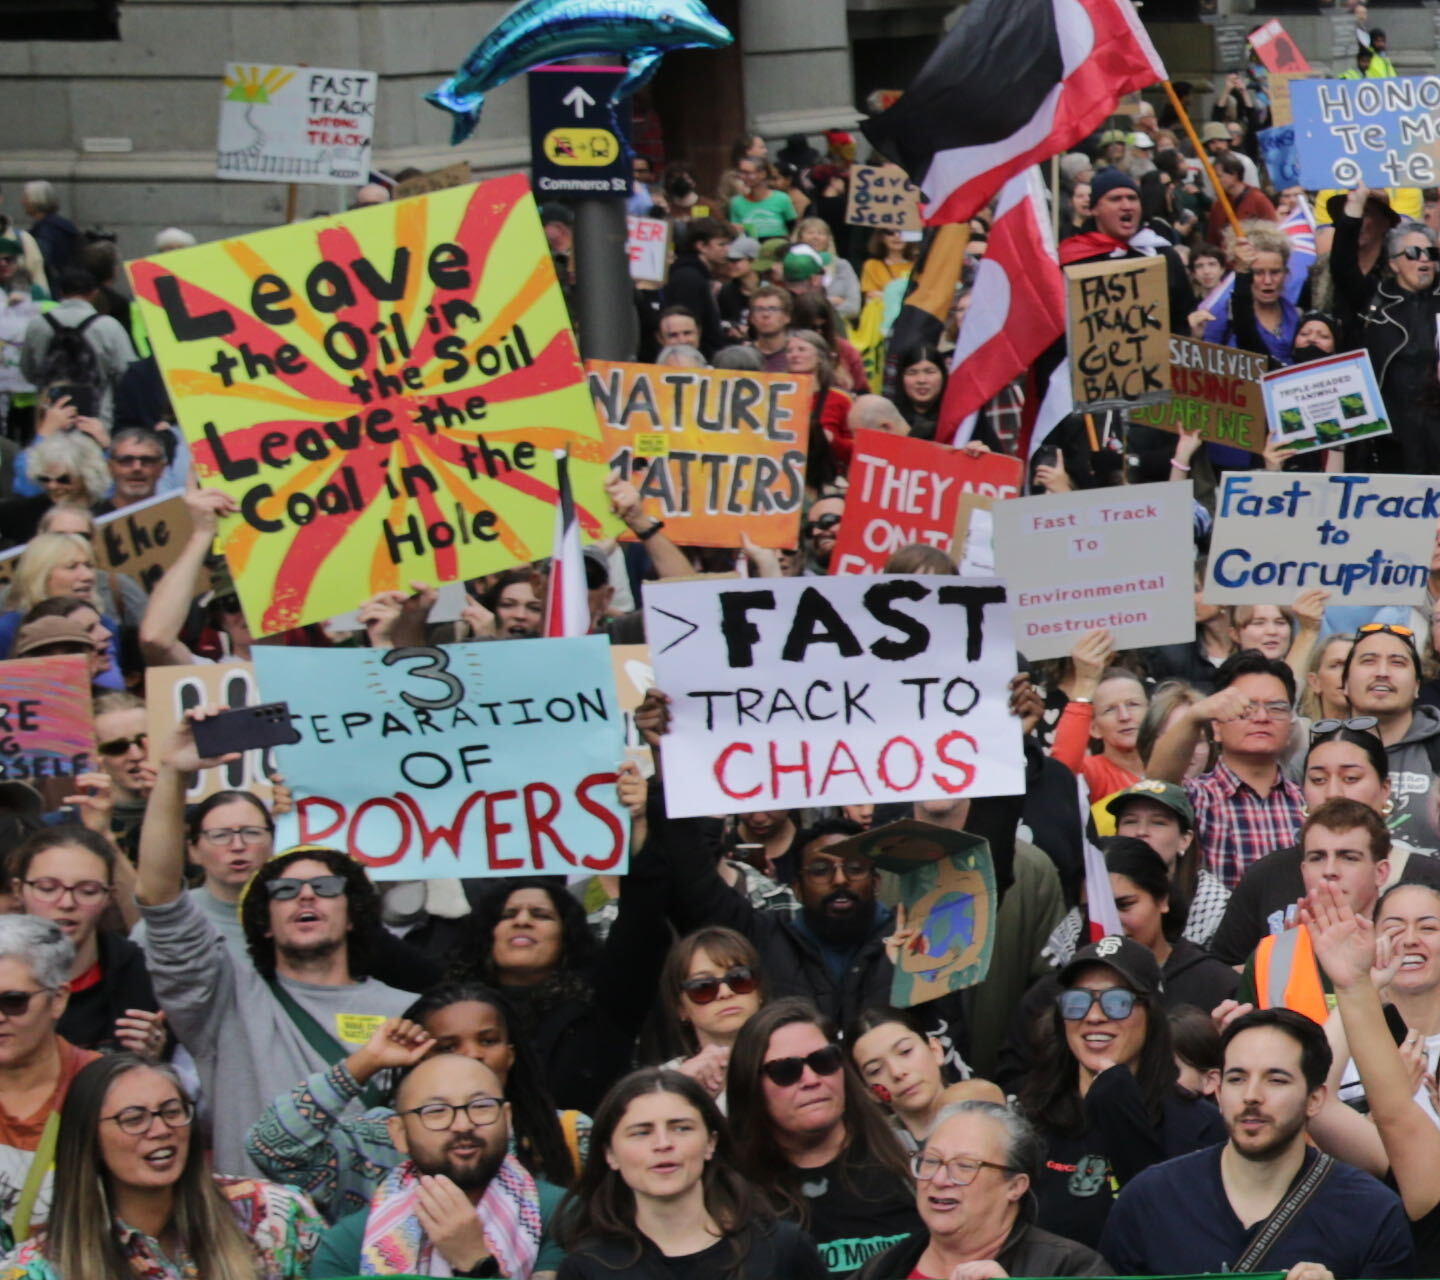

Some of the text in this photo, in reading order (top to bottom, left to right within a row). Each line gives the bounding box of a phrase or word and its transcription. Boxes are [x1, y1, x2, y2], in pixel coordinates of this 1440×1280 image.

[309, 76, 368, 97] FAST
[309, 97, 373, 116] TRACK
[1339, 124, 1386, 151] Te
[541, 178, 627, 192] Commerce St
[1334, 160, 1356, 182] o
[1391, 152, 1434, 182] te
[153, 242, 473, 345] Leave
[210, 298, 482, 388] the Oil in
[349, 324, 537, 404] the Soil
[1169, 338, 1266, 380] SEA LEVELS
[589, 372, 797, 442] NATURE
[1170, 367, 1247, 408] RISING
[1278, 374, 1352, 400] TRIPLE-HEADED
[201, 391, 489, 483] Leave the
[241, 434, 540, 535] Coal in the
[1220, 475, 1312, 518] Fast
[382, 501, 501, 566] Hole
[1032, 503, 1158, 532] Fast Track
[1317, 520, 1350, 546] to
[1072, 536, 1099, 553] To
[1018, 575, 1167, 609] Environmental
[1213, 547, 1430, 596] Corruption
[718, 578, 1006, 668] FAST
[1026, 607, 1149, 637] Destruction
[381, 645, 465, 710] 3
[687, 677, 981, 734] TRACK TO
[400, 744, 494, 790] OF
[713, 730, 978, 800] CHAOS
[298, 772, 625, 869] POWERS
